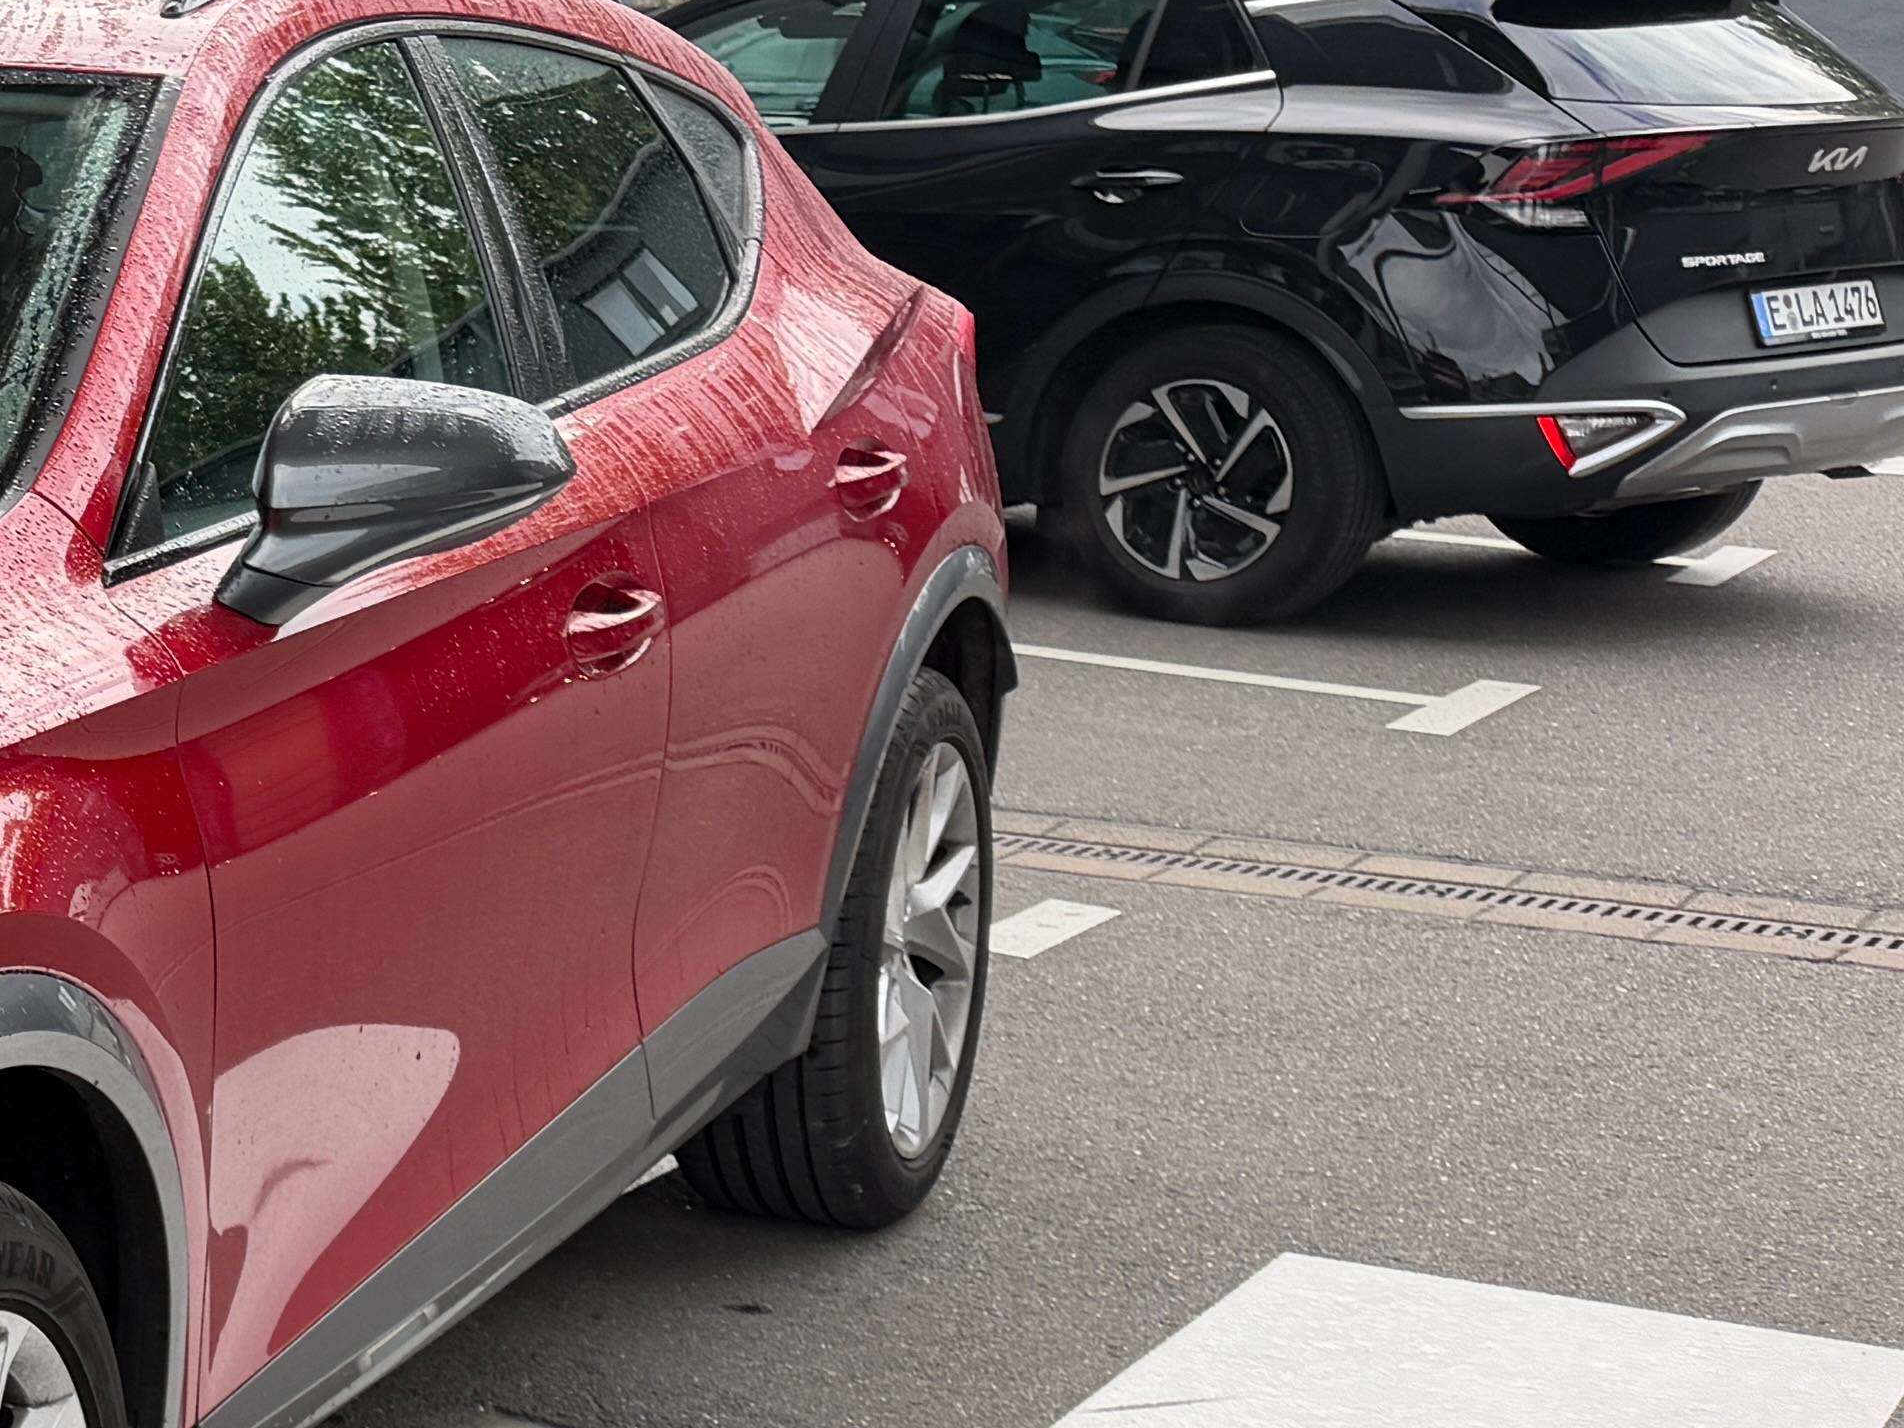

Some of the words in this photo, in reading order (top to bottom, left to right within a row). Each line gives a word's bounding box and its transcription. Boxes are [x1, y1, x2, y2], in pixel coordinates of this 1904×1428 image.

[1681, 252, 1766, 269] SPORTAGE
[1766, 294, 1787, 331] E
[1795, 291, 1829, 327] LA
[1829, 285, 1879, 323] 1476
